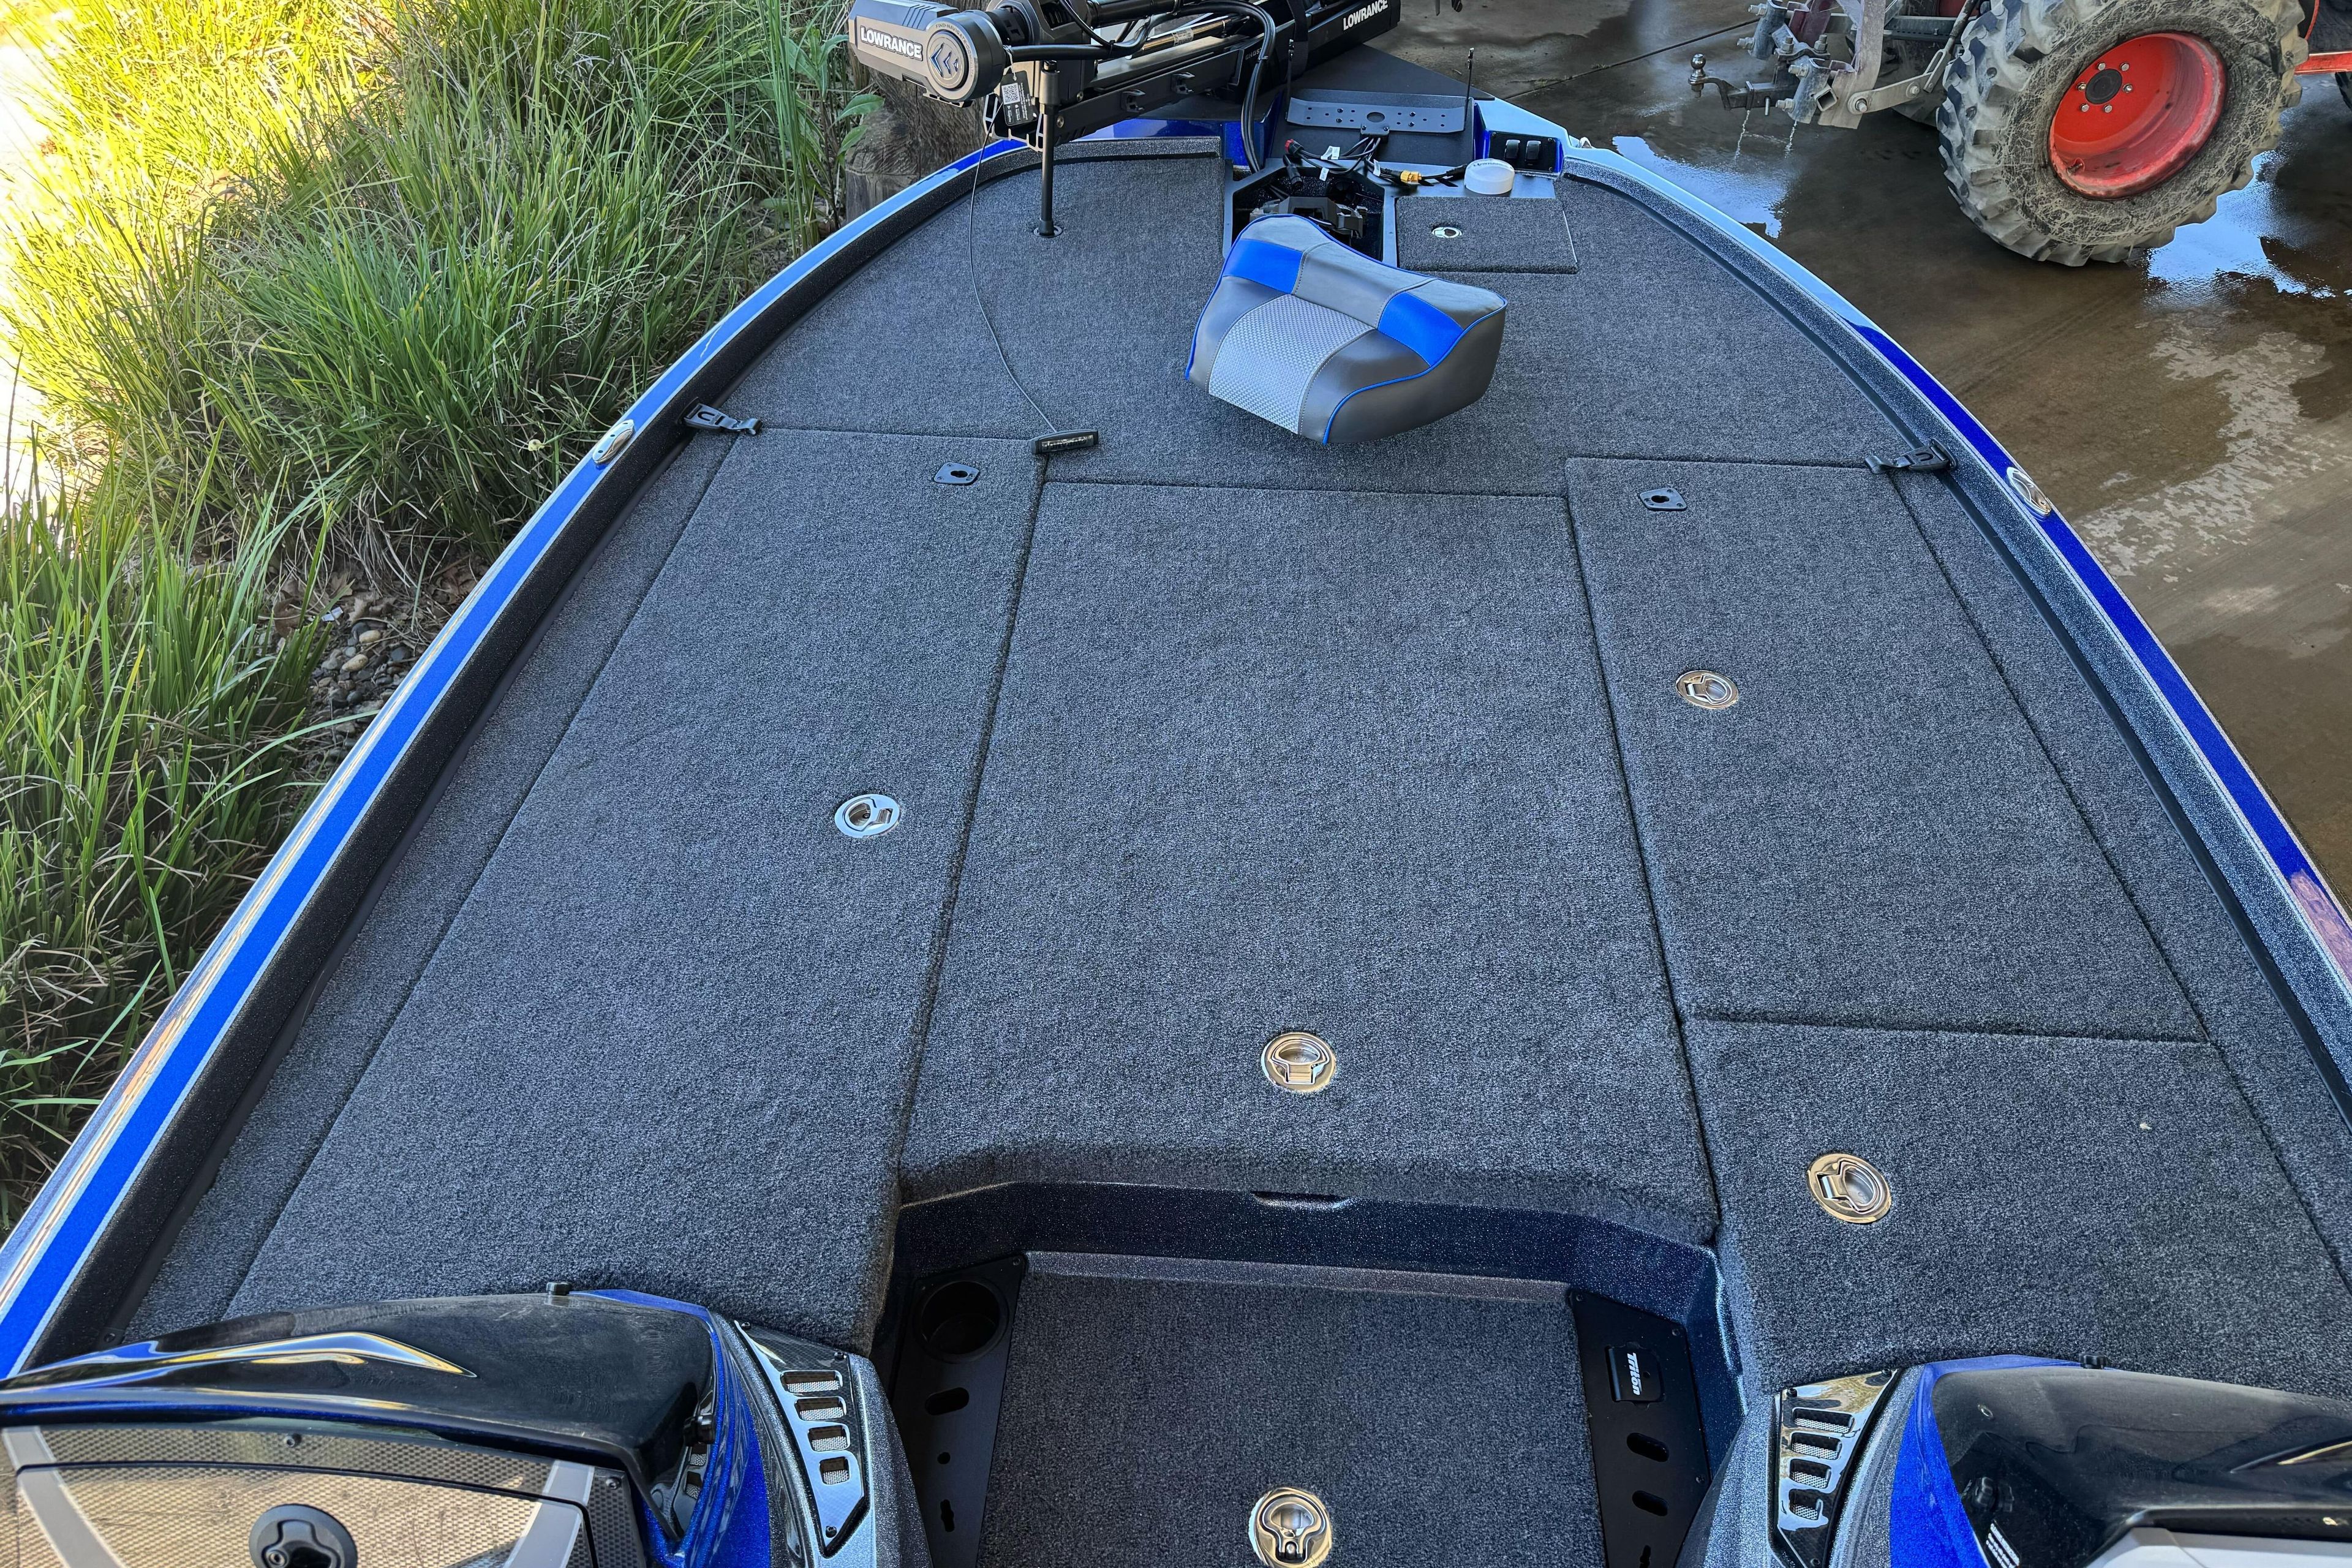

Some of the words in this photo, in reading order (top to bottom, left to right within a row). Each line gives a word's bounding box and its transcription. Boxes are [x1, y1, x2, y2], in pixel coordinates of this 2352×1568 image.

[1343, 0, 1389, 31] LOWRANCE
[860, 26, 923, 61] LOWRANCE
[1245, 47, 1262, 60] GHOS
[1627, 1352, 1642, 1395] Triton
